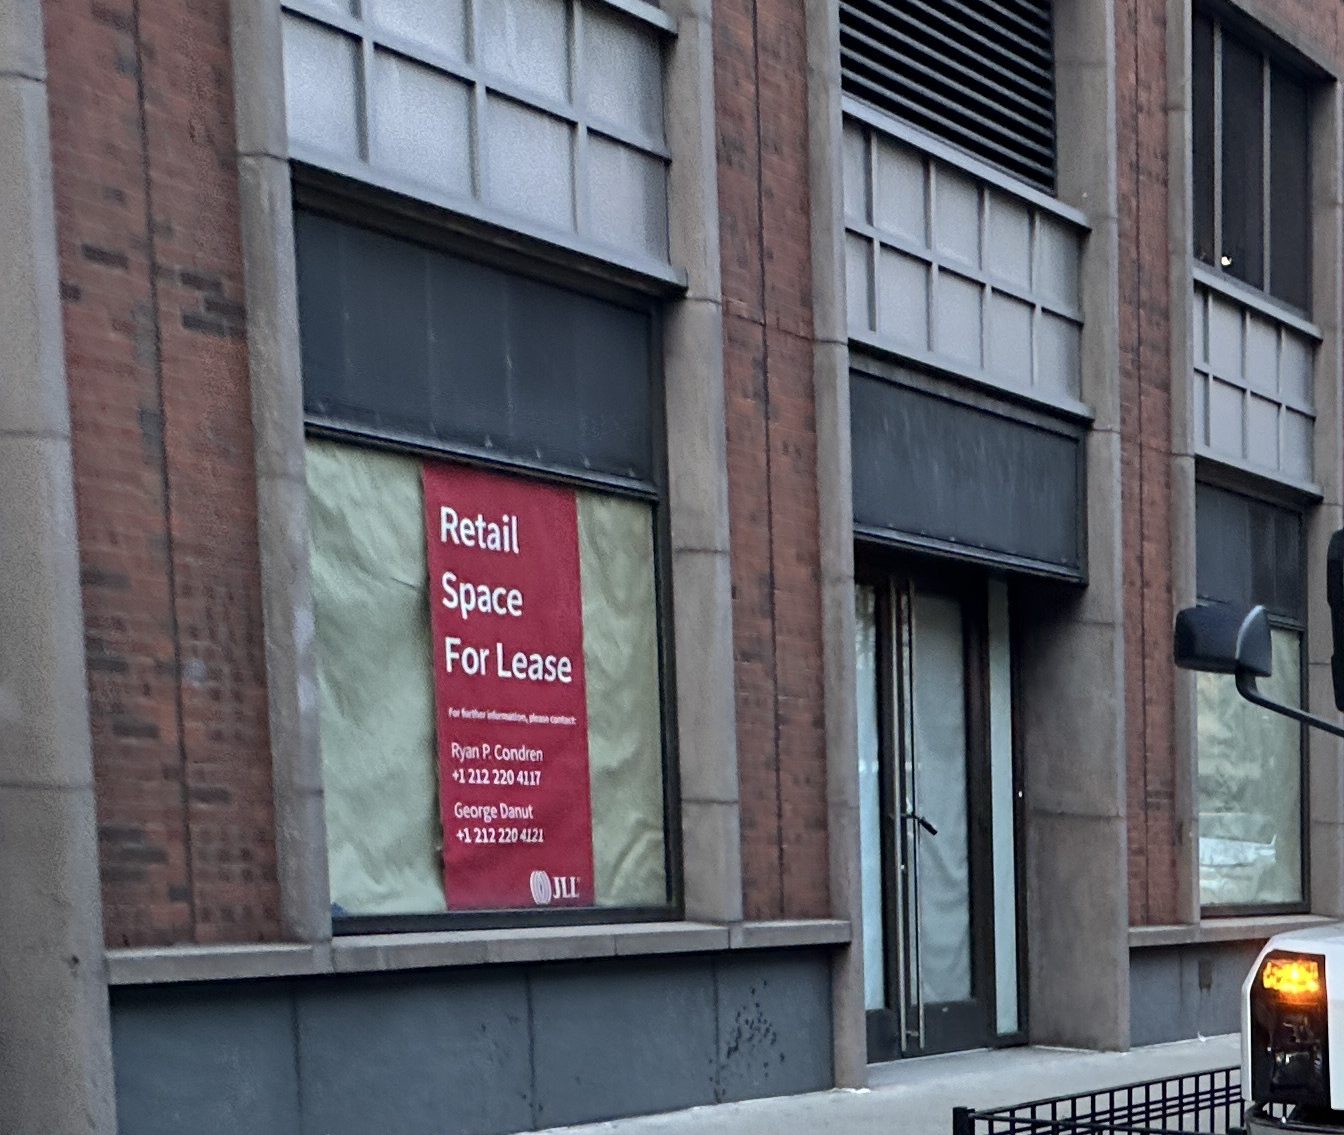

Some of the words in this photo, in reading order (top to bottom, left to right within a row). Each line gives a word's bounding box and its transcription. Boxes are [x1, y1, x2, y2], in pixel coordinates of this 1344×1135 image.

[440, 505, 520, 555] Retail
[441, 571, 524, 620] Space
[444, 636, 490, 676] For
[496, 642, 573, 684] Lease
[451, 742, 480, 764] Ryan
[482, 743, 492, 760] P.
[494, 744, 543, 762] Condren
[452, 768, 466, 784] +1
[468, 768, 490, 784] 212
[492, 768, 515, 785] 220
[516, 770, 541, 786] 4117
[454, 802, 497, 823] George
[499, 803, 534, 820] Danut
[456, 827, 472, 843] +1
[473, 827, 496, 844] 212
[498, 828, 519, 844] 220
[520, 828, 544, 843] 4121
[553, 876, 579, 899] JLL
